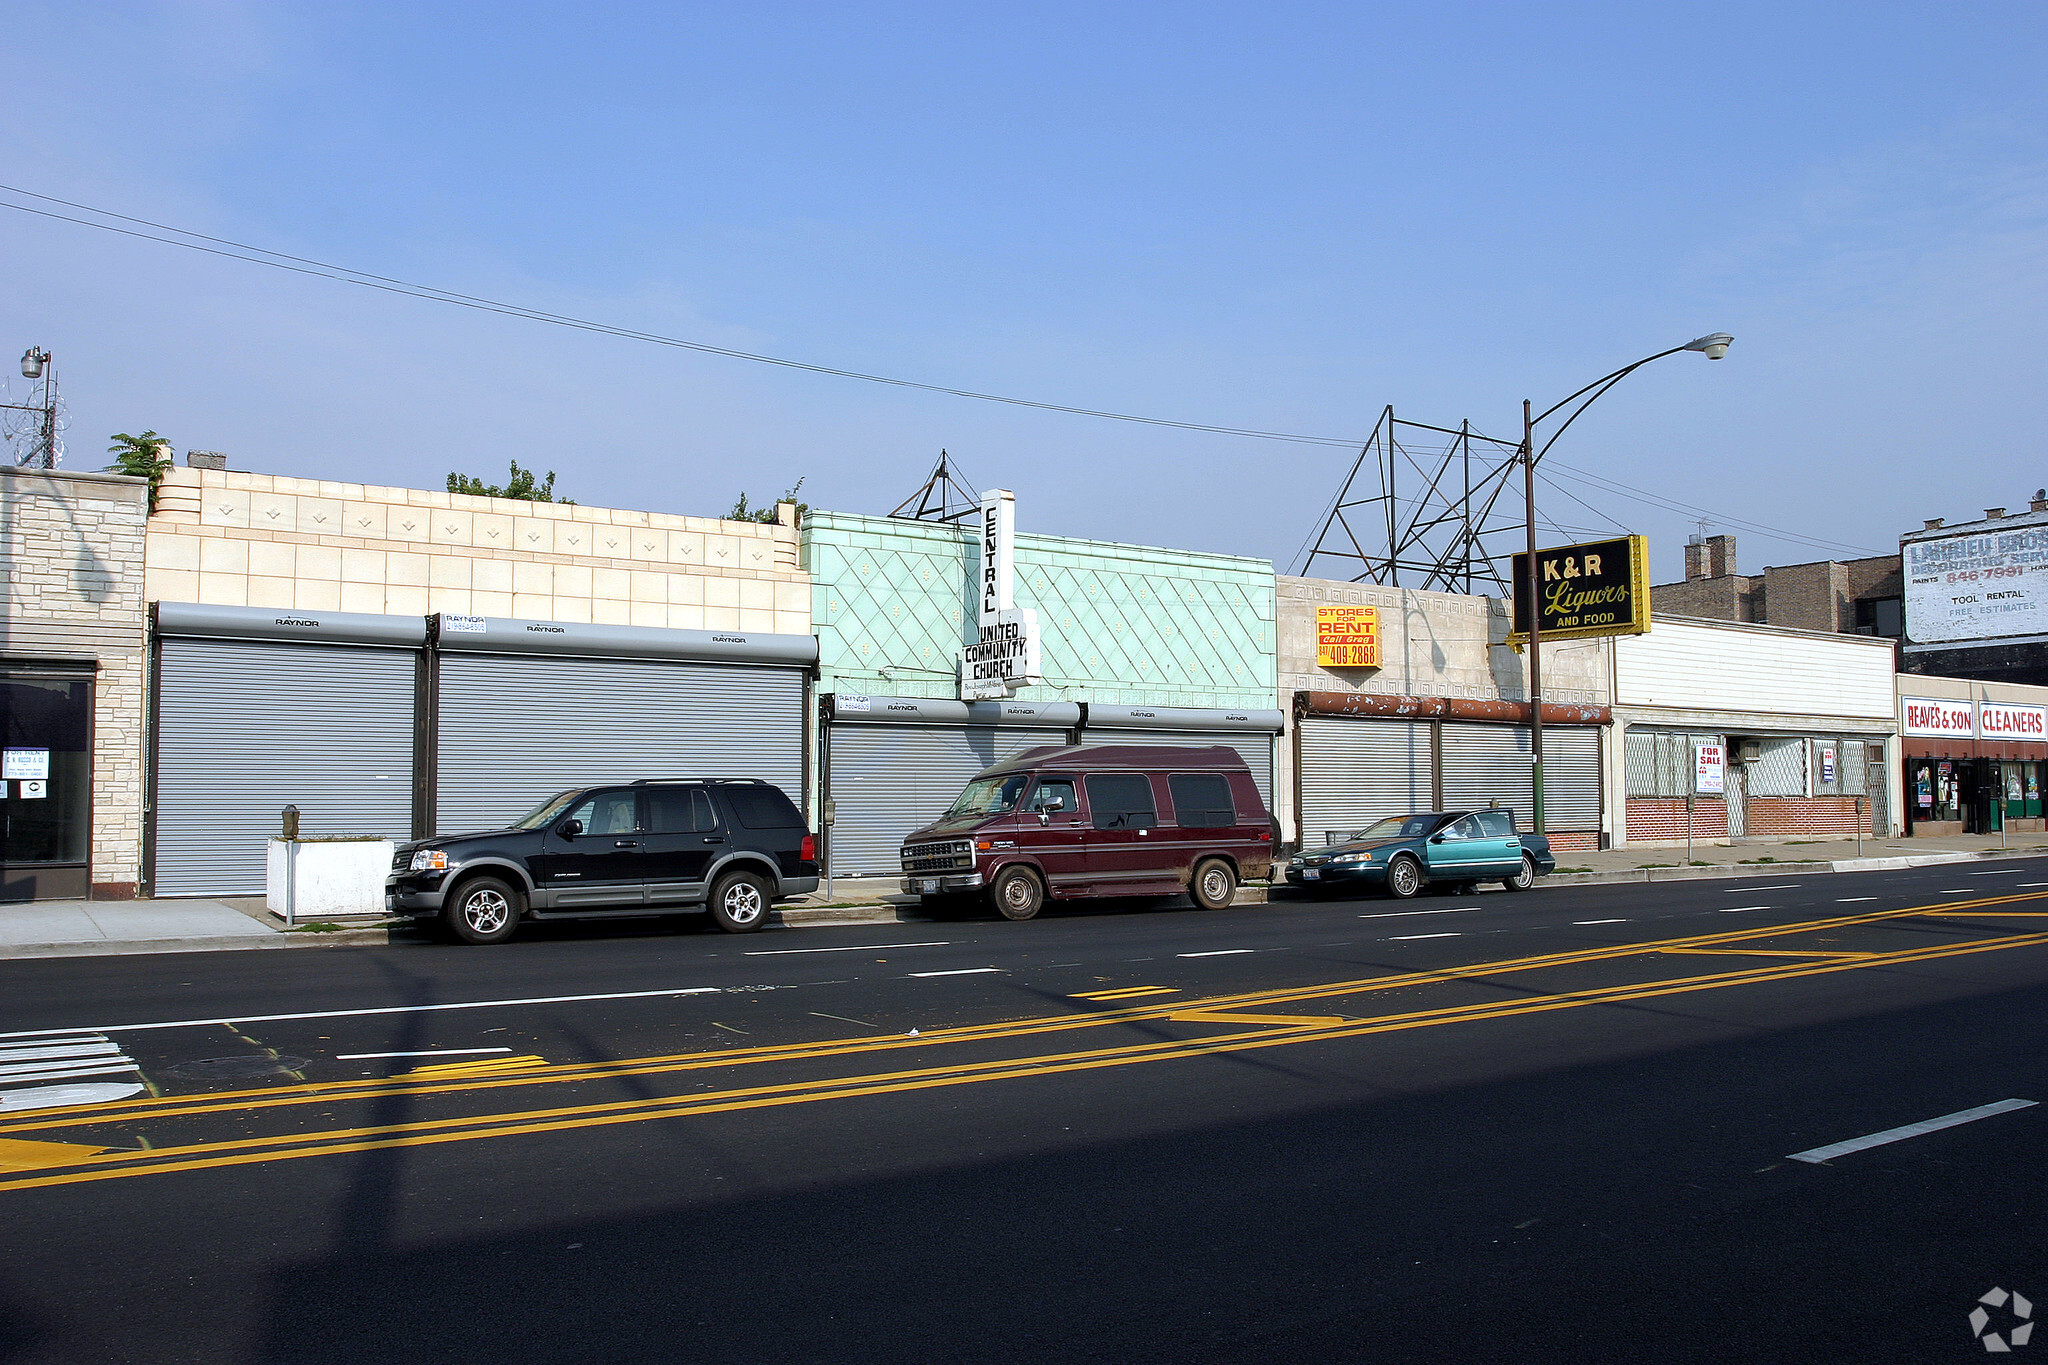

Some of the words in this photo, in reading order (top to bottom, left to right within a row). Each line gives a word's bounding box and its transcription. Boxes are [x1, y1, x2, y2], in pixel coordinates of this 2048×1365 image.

[984, 507, 998, 613] CENTRAL
[1543, 559, 1561, 581] K
[1563, 556, 1581, 579] &
[1584, 554, 1602, 576] R
[1912, 576, 1939, 585] PAINTS
[1544, 580, 1630, 616] Liquors
[1951, 594, 1979, 605] TOOL
[1986, 590, 2025, 601] RENTAL
[1318, 608, 1374, 616] STORES
[1949, 607, 1973, 617] FREE
[1980, 602, 2036, 614] ESTIMATES
[275, 618, 320, 628] RAYNOR
[446, 615, 485, 623] RAYNOR
[1556, 616, 1579, 627] AND
[1584, 612, 1615, 625] FOOD
[526, 625, 565, 634] RAYNOR
[979, 622, 1019, 643] UNITED
[1318, 622, 1374, 634] RENT
[712, 635, 747, 644] RAYNOR
[1323, 635, 1343, 643] Call
[965, 638, 1025, 663] COMMUNITY
[973, 659, 1013, 680] CHURCH
[887, 704, 918, 712] RAYNOR
[1007, 707, 1035, 715] RAYNOR
[1941, 710, 1951, 729] &
[1951, 711, 1972, 731] SON
[1982, 709, 2043, 733] CLEANERS
[1702, 747, 1719, 756] FOR
[1699, 756, 1721, 765] SALE
